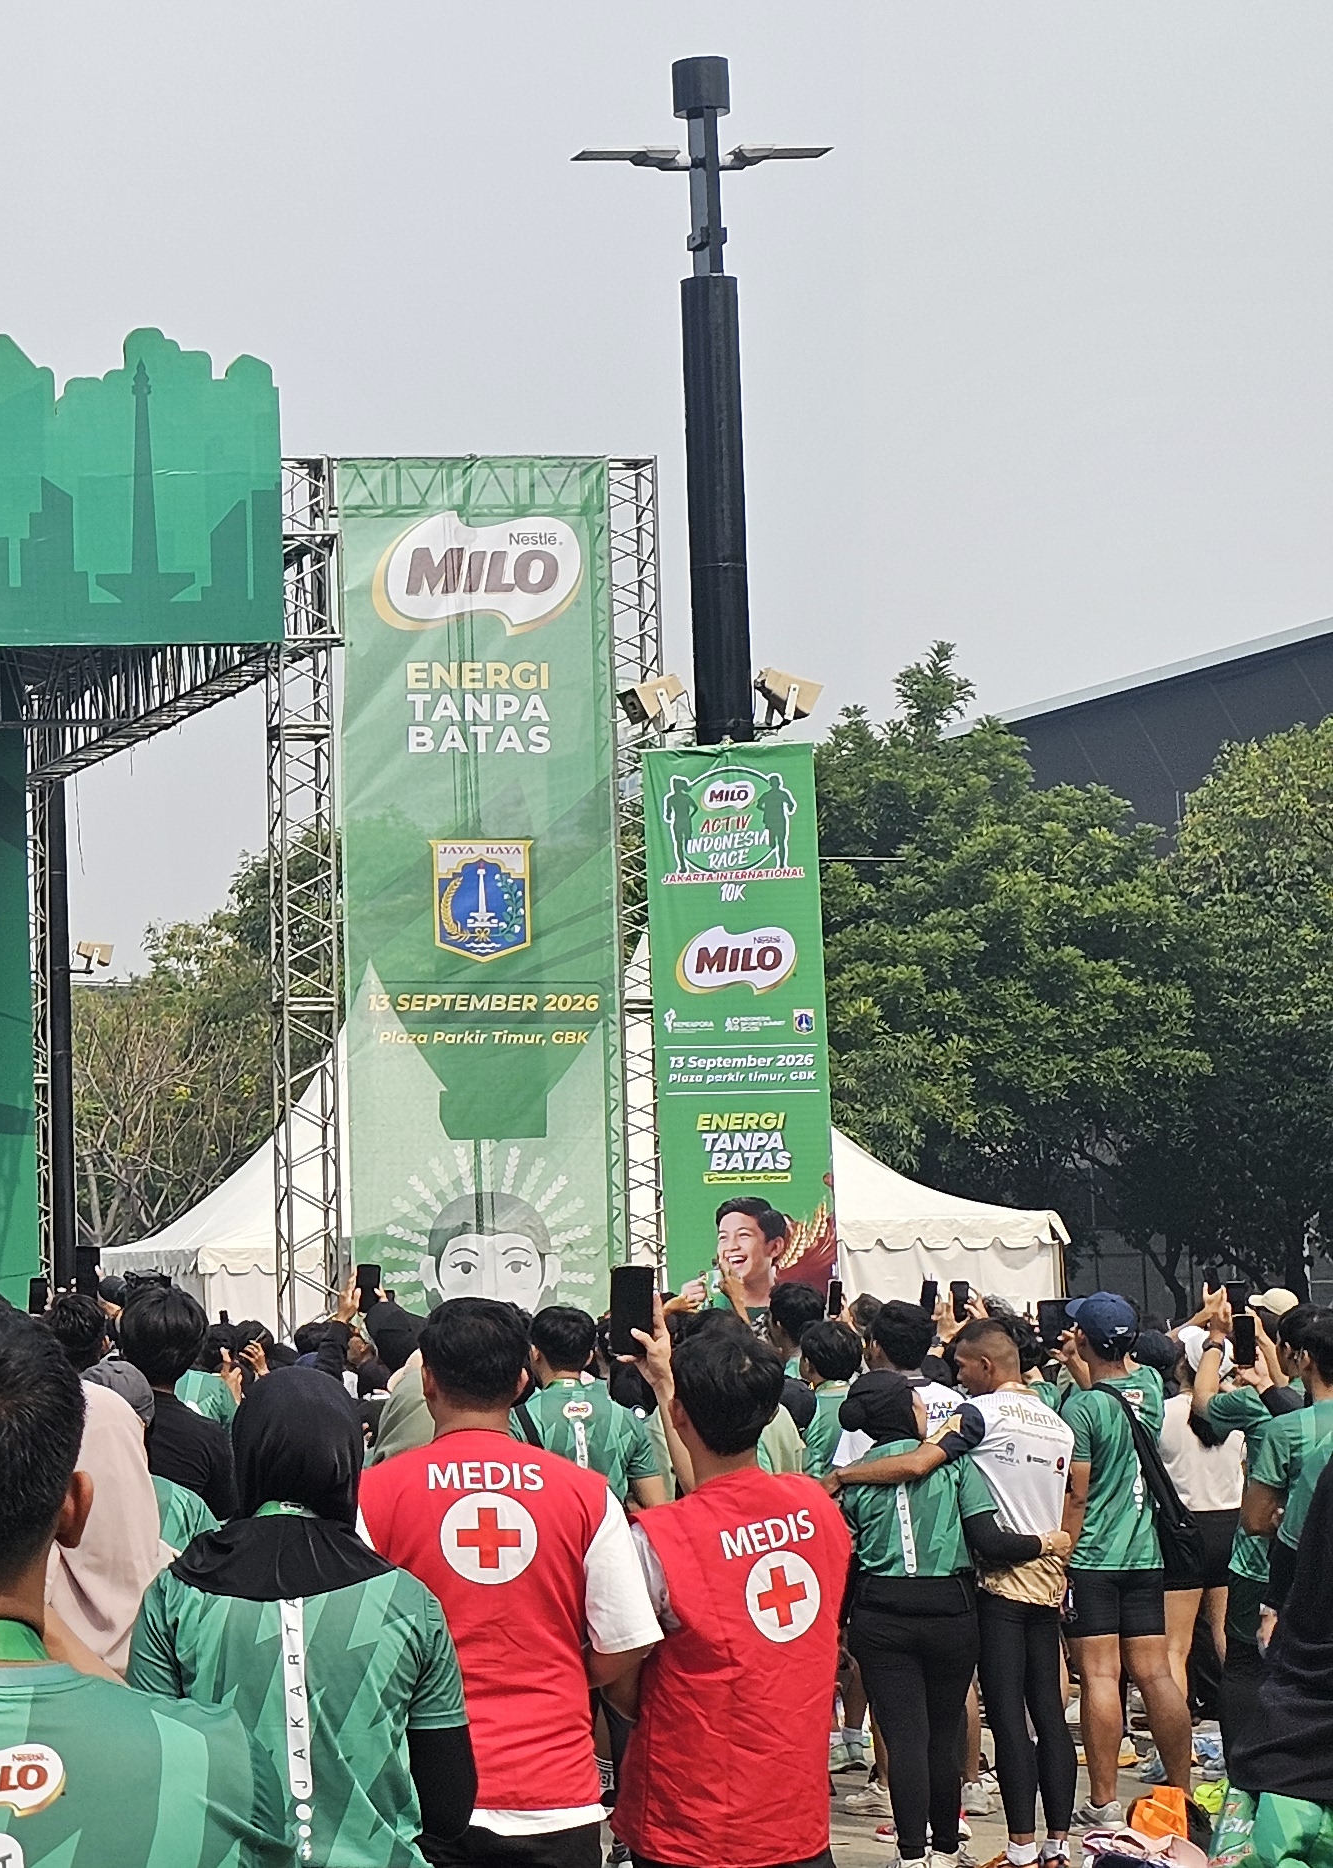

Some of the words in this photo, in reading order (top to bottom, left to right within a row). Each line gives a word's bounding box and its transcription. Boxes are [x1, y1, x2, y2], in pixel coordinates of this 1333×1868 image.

[406, 547, 560, 596] MILO
[406, 662, 549, 690] ENERGI
[406, 694, 551, 722] TANPA
[408, 726, 552, 754] BATAS
[708, 789, 749, 802] MILO
[700, 814, 752, 835] ACTIV
[439, 846, 475, 855] JAYA
[687, 829, 770, 854] INDONESIA
[707, 848, 750, 870] RACE
[663, 873, 713, 884] JAKARTA
[716, 868, 804, 881] INTERNATIONAL
[720, 883, 746, 901] 10K
[695, 945, 783, 974] MILO
[368, 994, 391, 1012] 13
[396, 993, 538, 1012] SEPTEMBER
[543, 993, 600, 1012] 2026
[379, 1030, 428, 1045] Plaza
[433, 1030, 487, 1045] Parkir
[491, 1030, 547, 1047] Timur,
[552, 1031, 590, 1045] GBK
[669, 1056, 685, 1068] 13
[687, 1055, 774, 1071] September
[776, 1054, 815, 1067] 2026
[668, 1073, 703, 1083] Plaza
[706, 1072, 745, 1084] parkir
[789, 1071, 817, 1081] GBK
[697, 1112, 786, 1131] ENERGI
[702, 1132, 784, 1151] TANPA
[710, 1152, 792, 1171] BATAS
[427, 1462, 544, 1492] MEDIS
[720, 1509, 816, 1560] MEDIS
